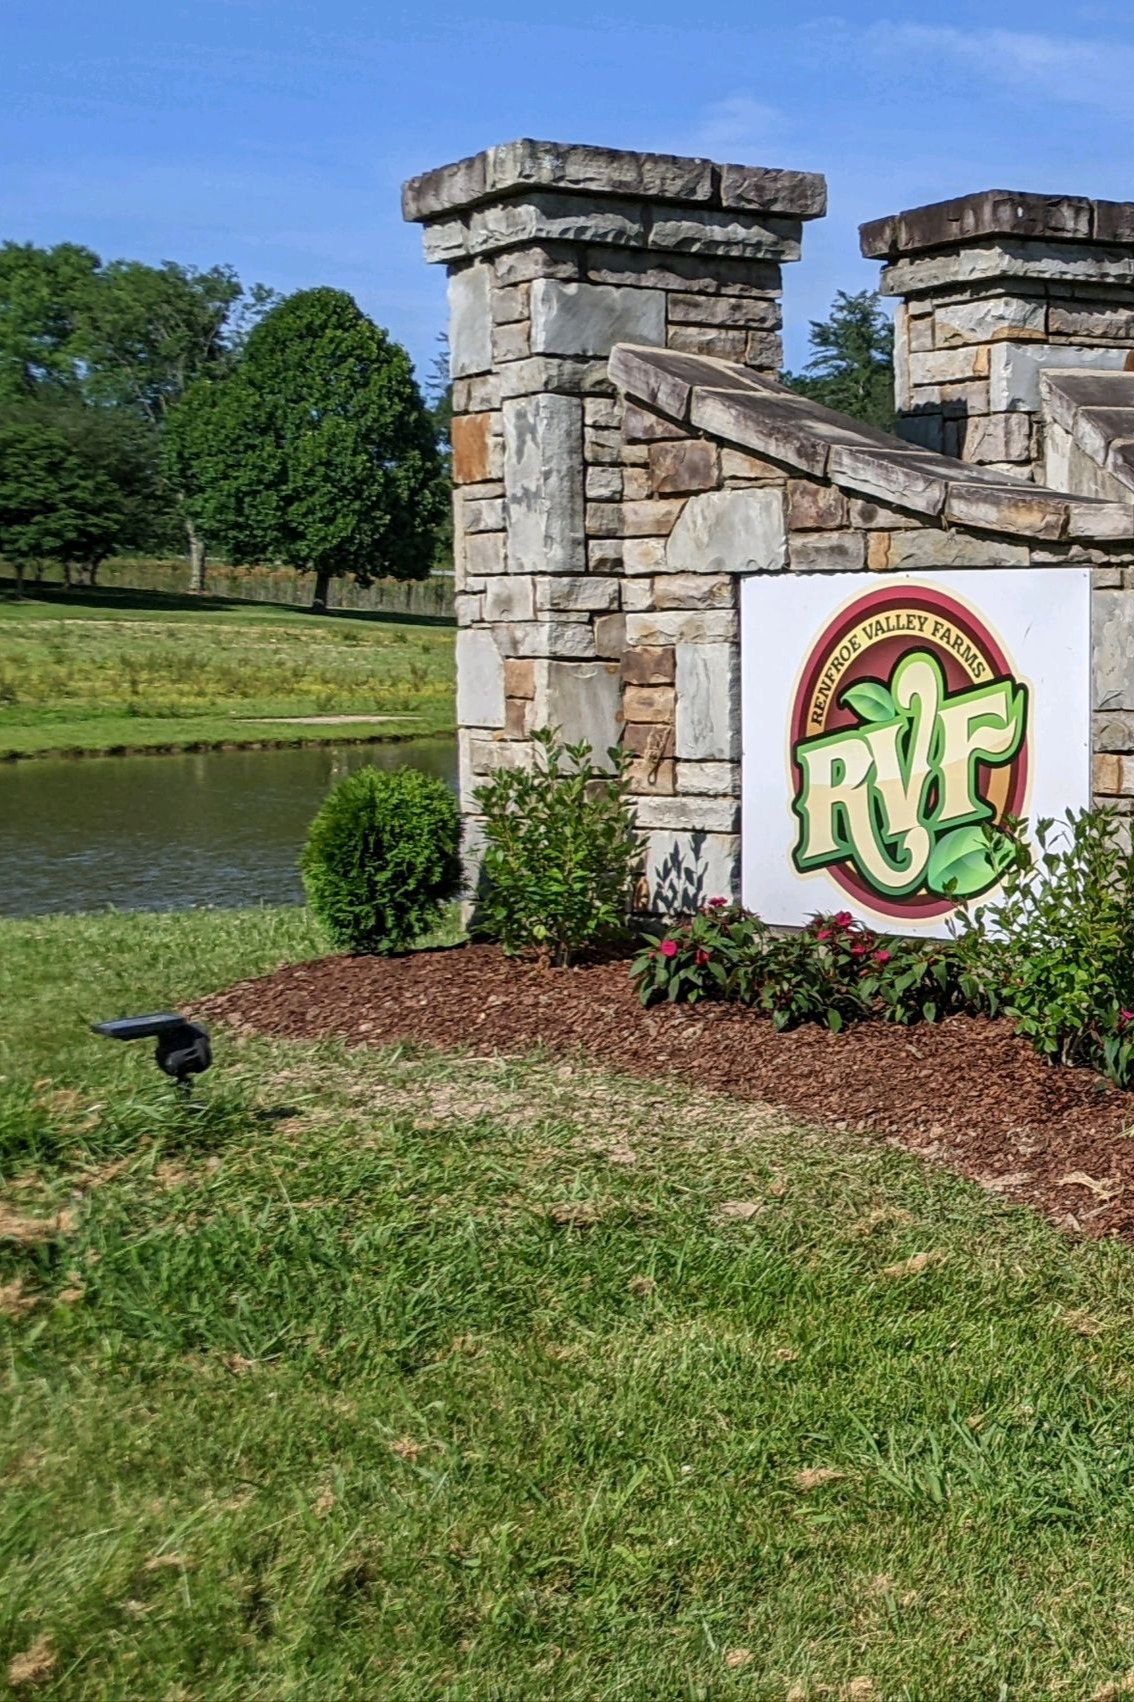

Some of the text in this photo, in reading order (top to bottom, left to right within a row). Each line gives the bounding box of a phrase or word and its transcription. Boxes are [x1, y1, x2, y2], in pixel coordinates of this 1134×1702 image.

[811, 613, 986, 726] RENFROE VALLEY FARMS
[798, 656, 1022, 891] RVF
